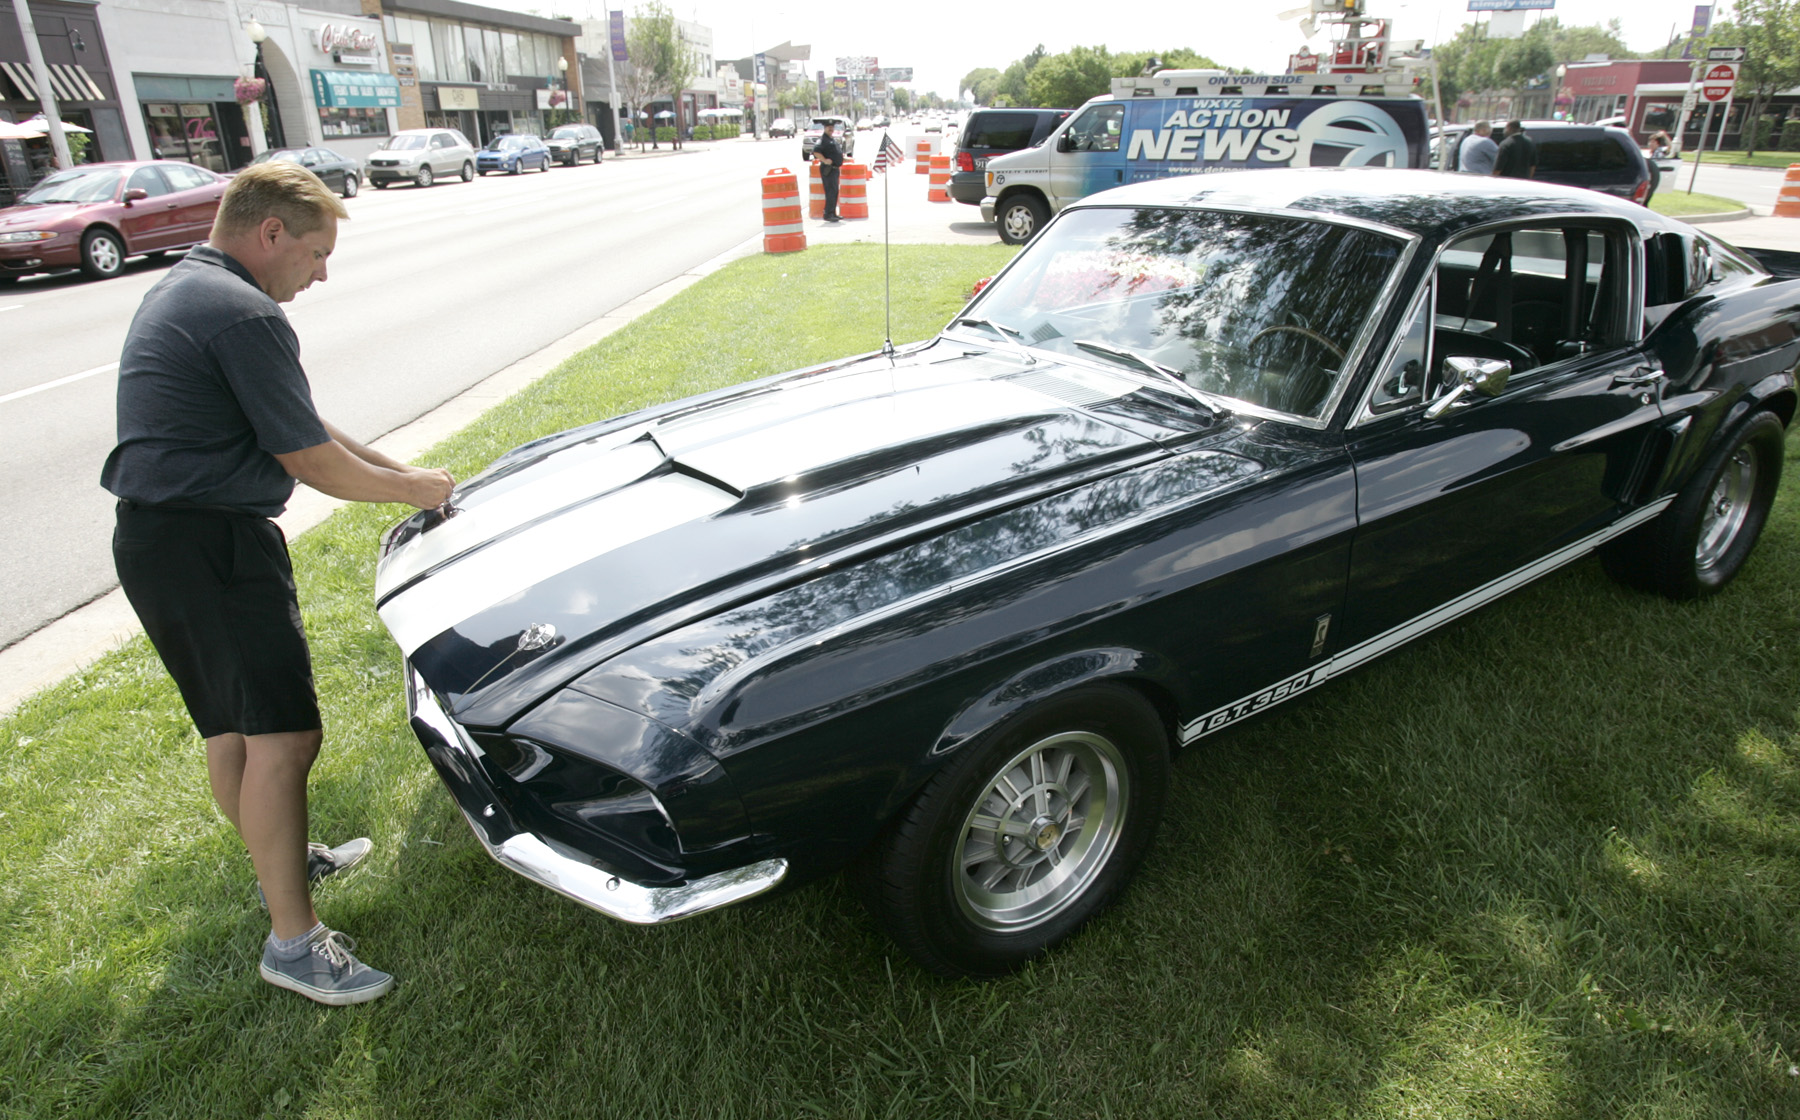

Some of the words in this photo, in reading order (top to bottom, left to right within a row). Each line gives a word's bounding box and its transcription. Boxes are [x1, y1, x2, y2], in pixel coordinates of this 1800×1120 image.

[1471, 0, 1515, 9] simply
[1208, 77, 1228, 85] ON
[1232, 76, 1268, 85] YOUR
[1271, 75, 1304, 84] SIDE
[1193, 100, 1244, 109] WXYZ
[1164, 109, 1291, 128] ACTION
[1126, 128, 1300, 162] NEWS
[1252, 674, 1310, 710] 350
